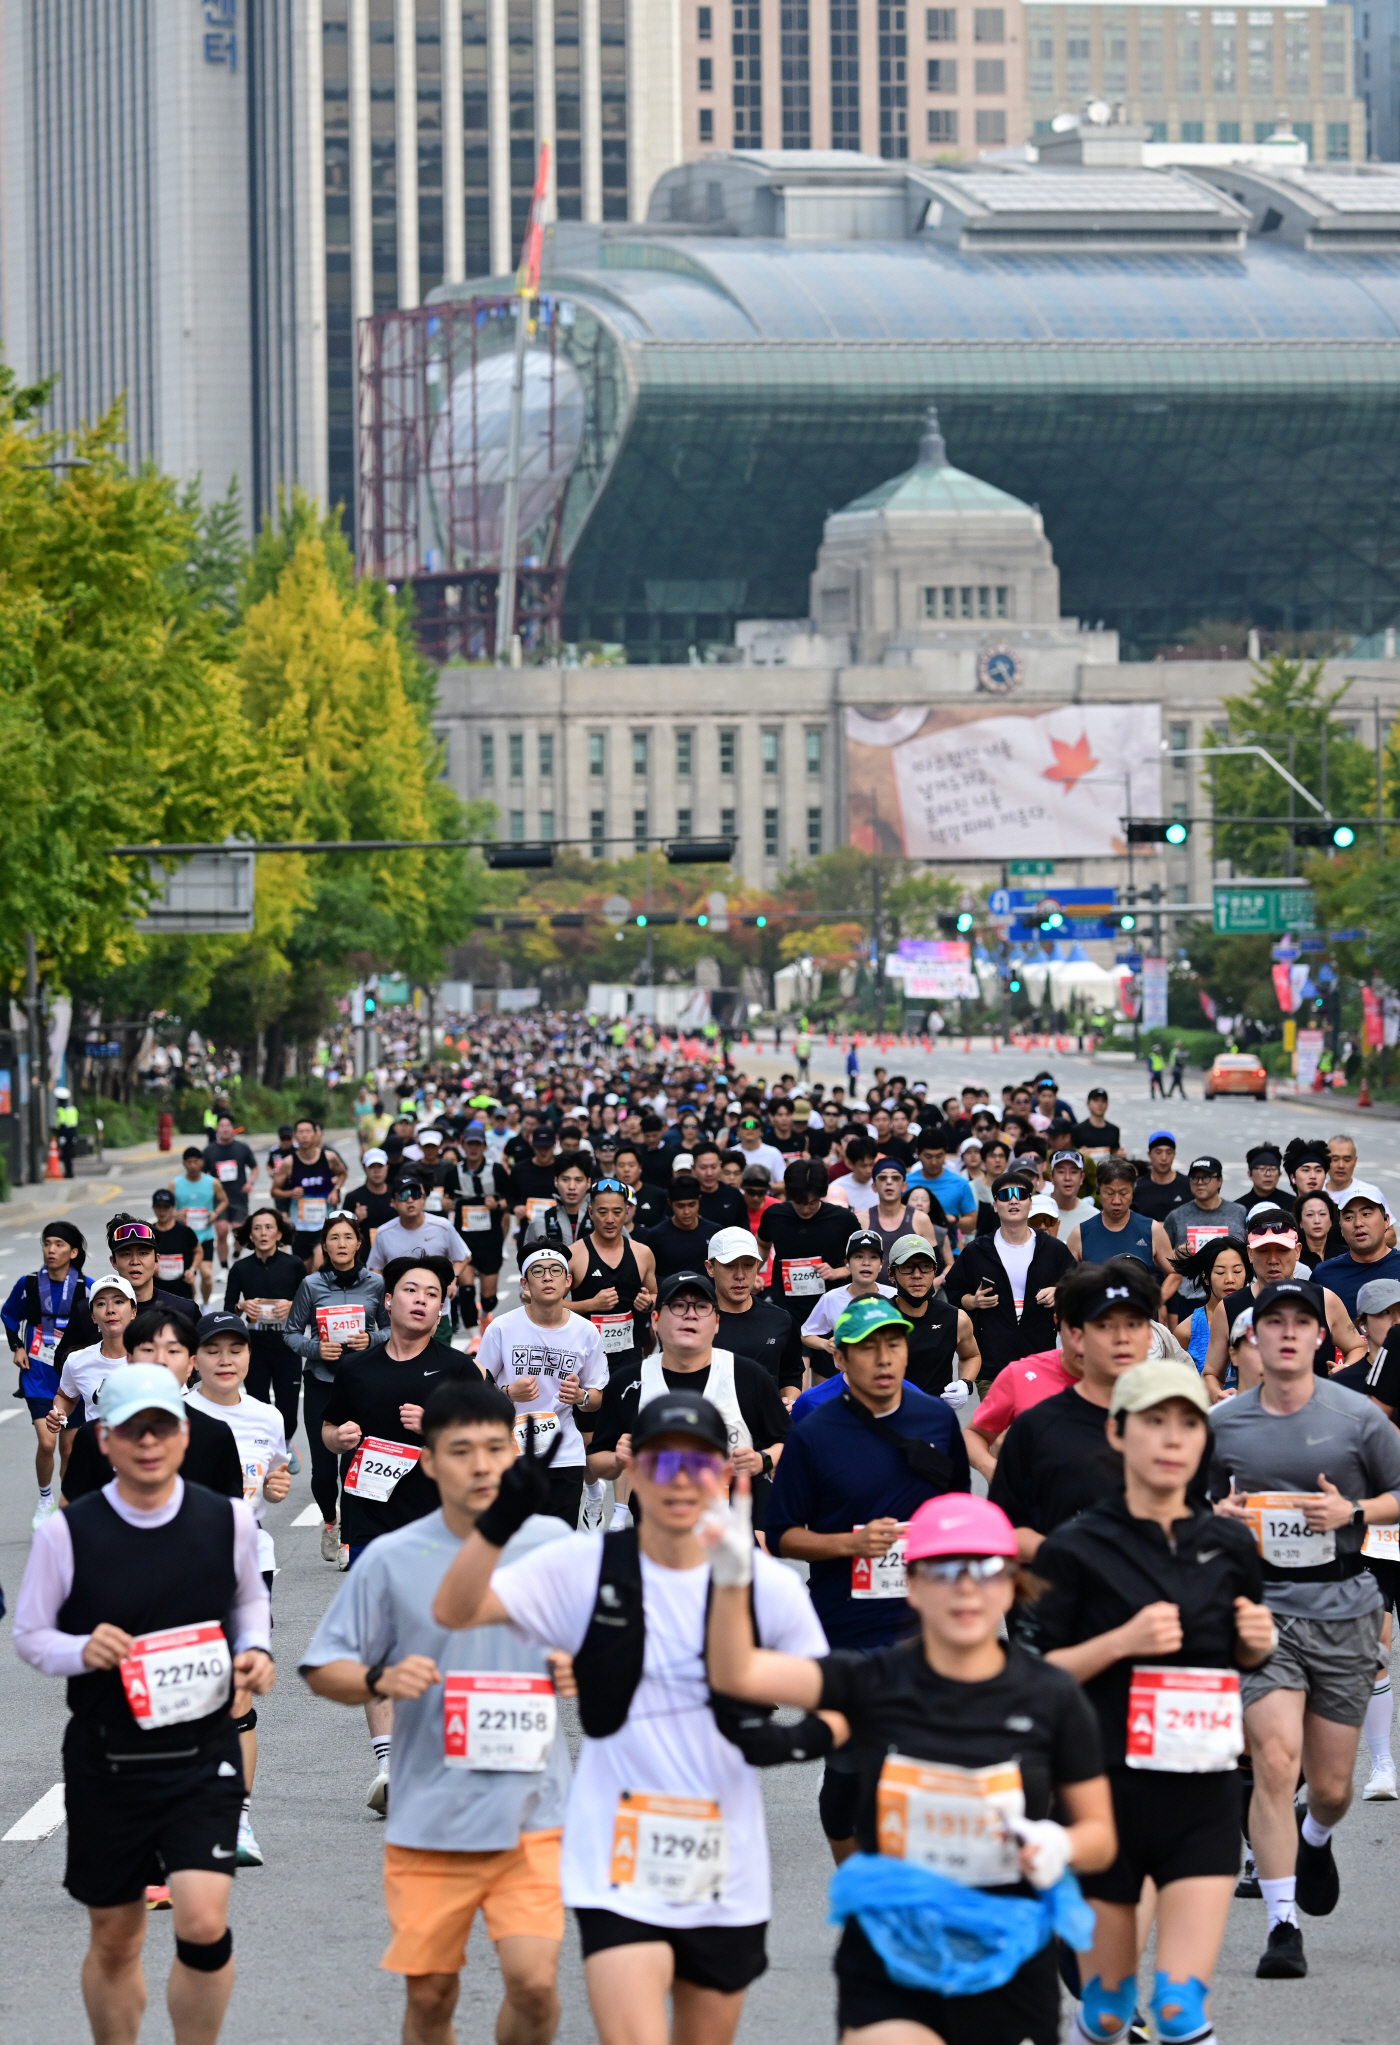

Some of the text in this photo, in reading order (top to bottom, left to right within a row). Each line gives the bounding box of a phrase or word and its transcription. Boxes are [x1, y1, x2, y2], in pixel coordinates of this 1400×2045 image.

[320, 1324, 328, 1333] A
[332, 1319, 360, 1331] 24151
[604, 1325, 631, 1338] 22679
[515, 1366, 524, 1376] EAT
[527, 1366, 542, 1376] SLEEP
[349, 1461, 358, 1473] A
[855, 1558, 870, 1573] A
[153, 1658, 223, 1688] 22740
[128, 1678, 147, 1699] A
[446, 1713, 466, 1736] A
[478, 1710, 548, 1732] 22158
[1131, 1712, 1153, 1735] A
[879, 1809, 903, 1835] A
[614, 1835, 634, 1859] A
[651, 1832, 721, 1862] 12961
